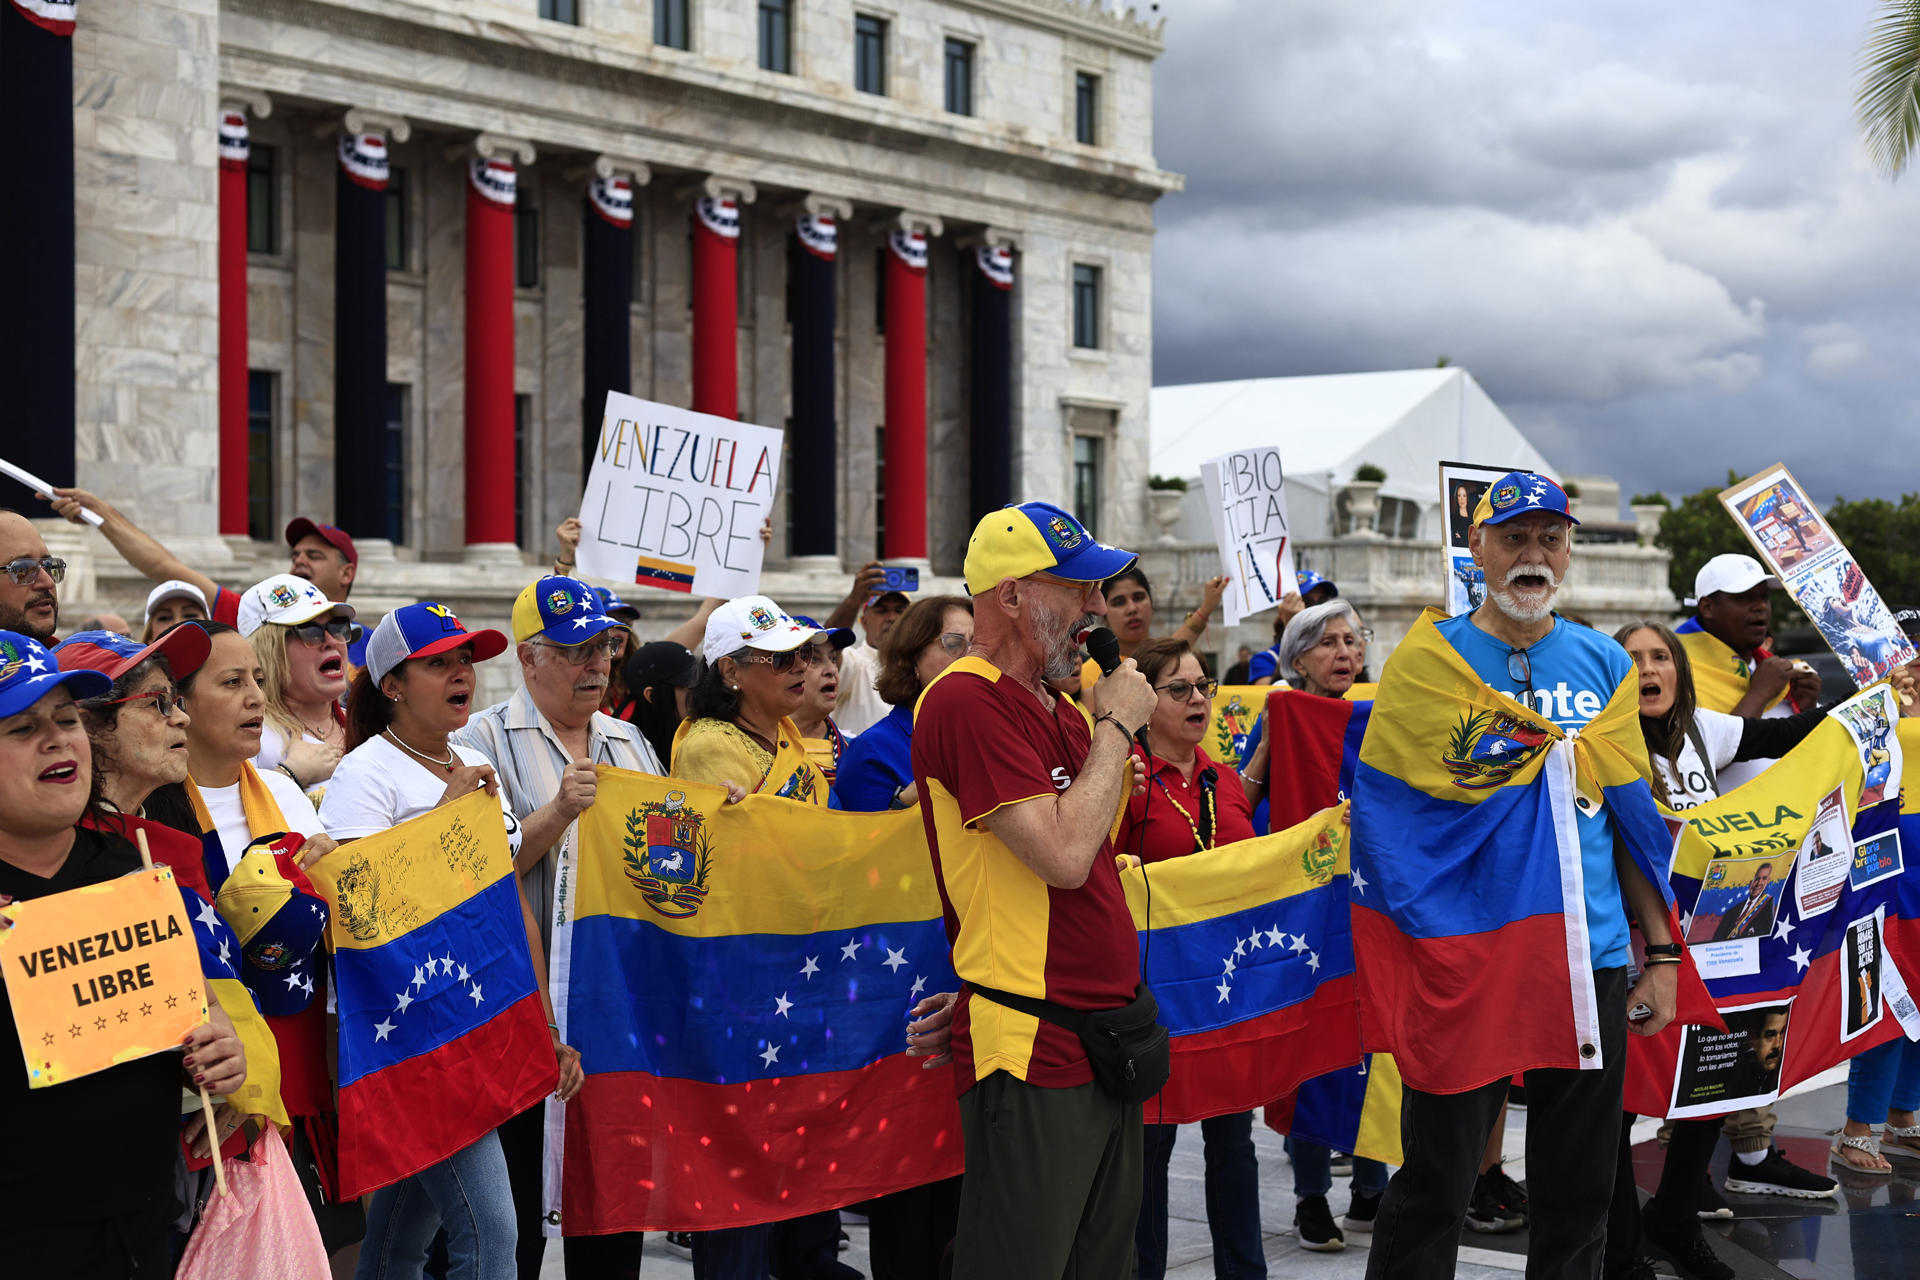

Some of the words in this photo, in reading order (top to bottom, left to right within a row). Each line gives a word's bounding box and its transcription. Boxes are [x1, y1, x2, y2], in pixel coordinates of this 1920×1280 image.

[601, 416, 773, 498] VENEZUELA
[597, 480, 761, 573] LIBRE
[1856, 667, 1874, 685] 28
[1858, 842, 1880, 857] Gloria
[1854, 853, 1878, 869] bravo
[1865, 856, 1893, 876] pueblo
[1857, 926, 1875, 946] ARMAS
[19, 914, 183, 979] VENEZUELA
[1858, 948, 1875, 970] ACTAS
[72, 962, 154, 1007] LIBRE
[1697, 1035, 1706, 1043] Lo
[1706, 1034, 1718, 1043] que
[1734, 1030, 1748, 1040] pudo
[1714, 1043, 1724, 1051] los
[1708, 1062, 1718, 1070] las
